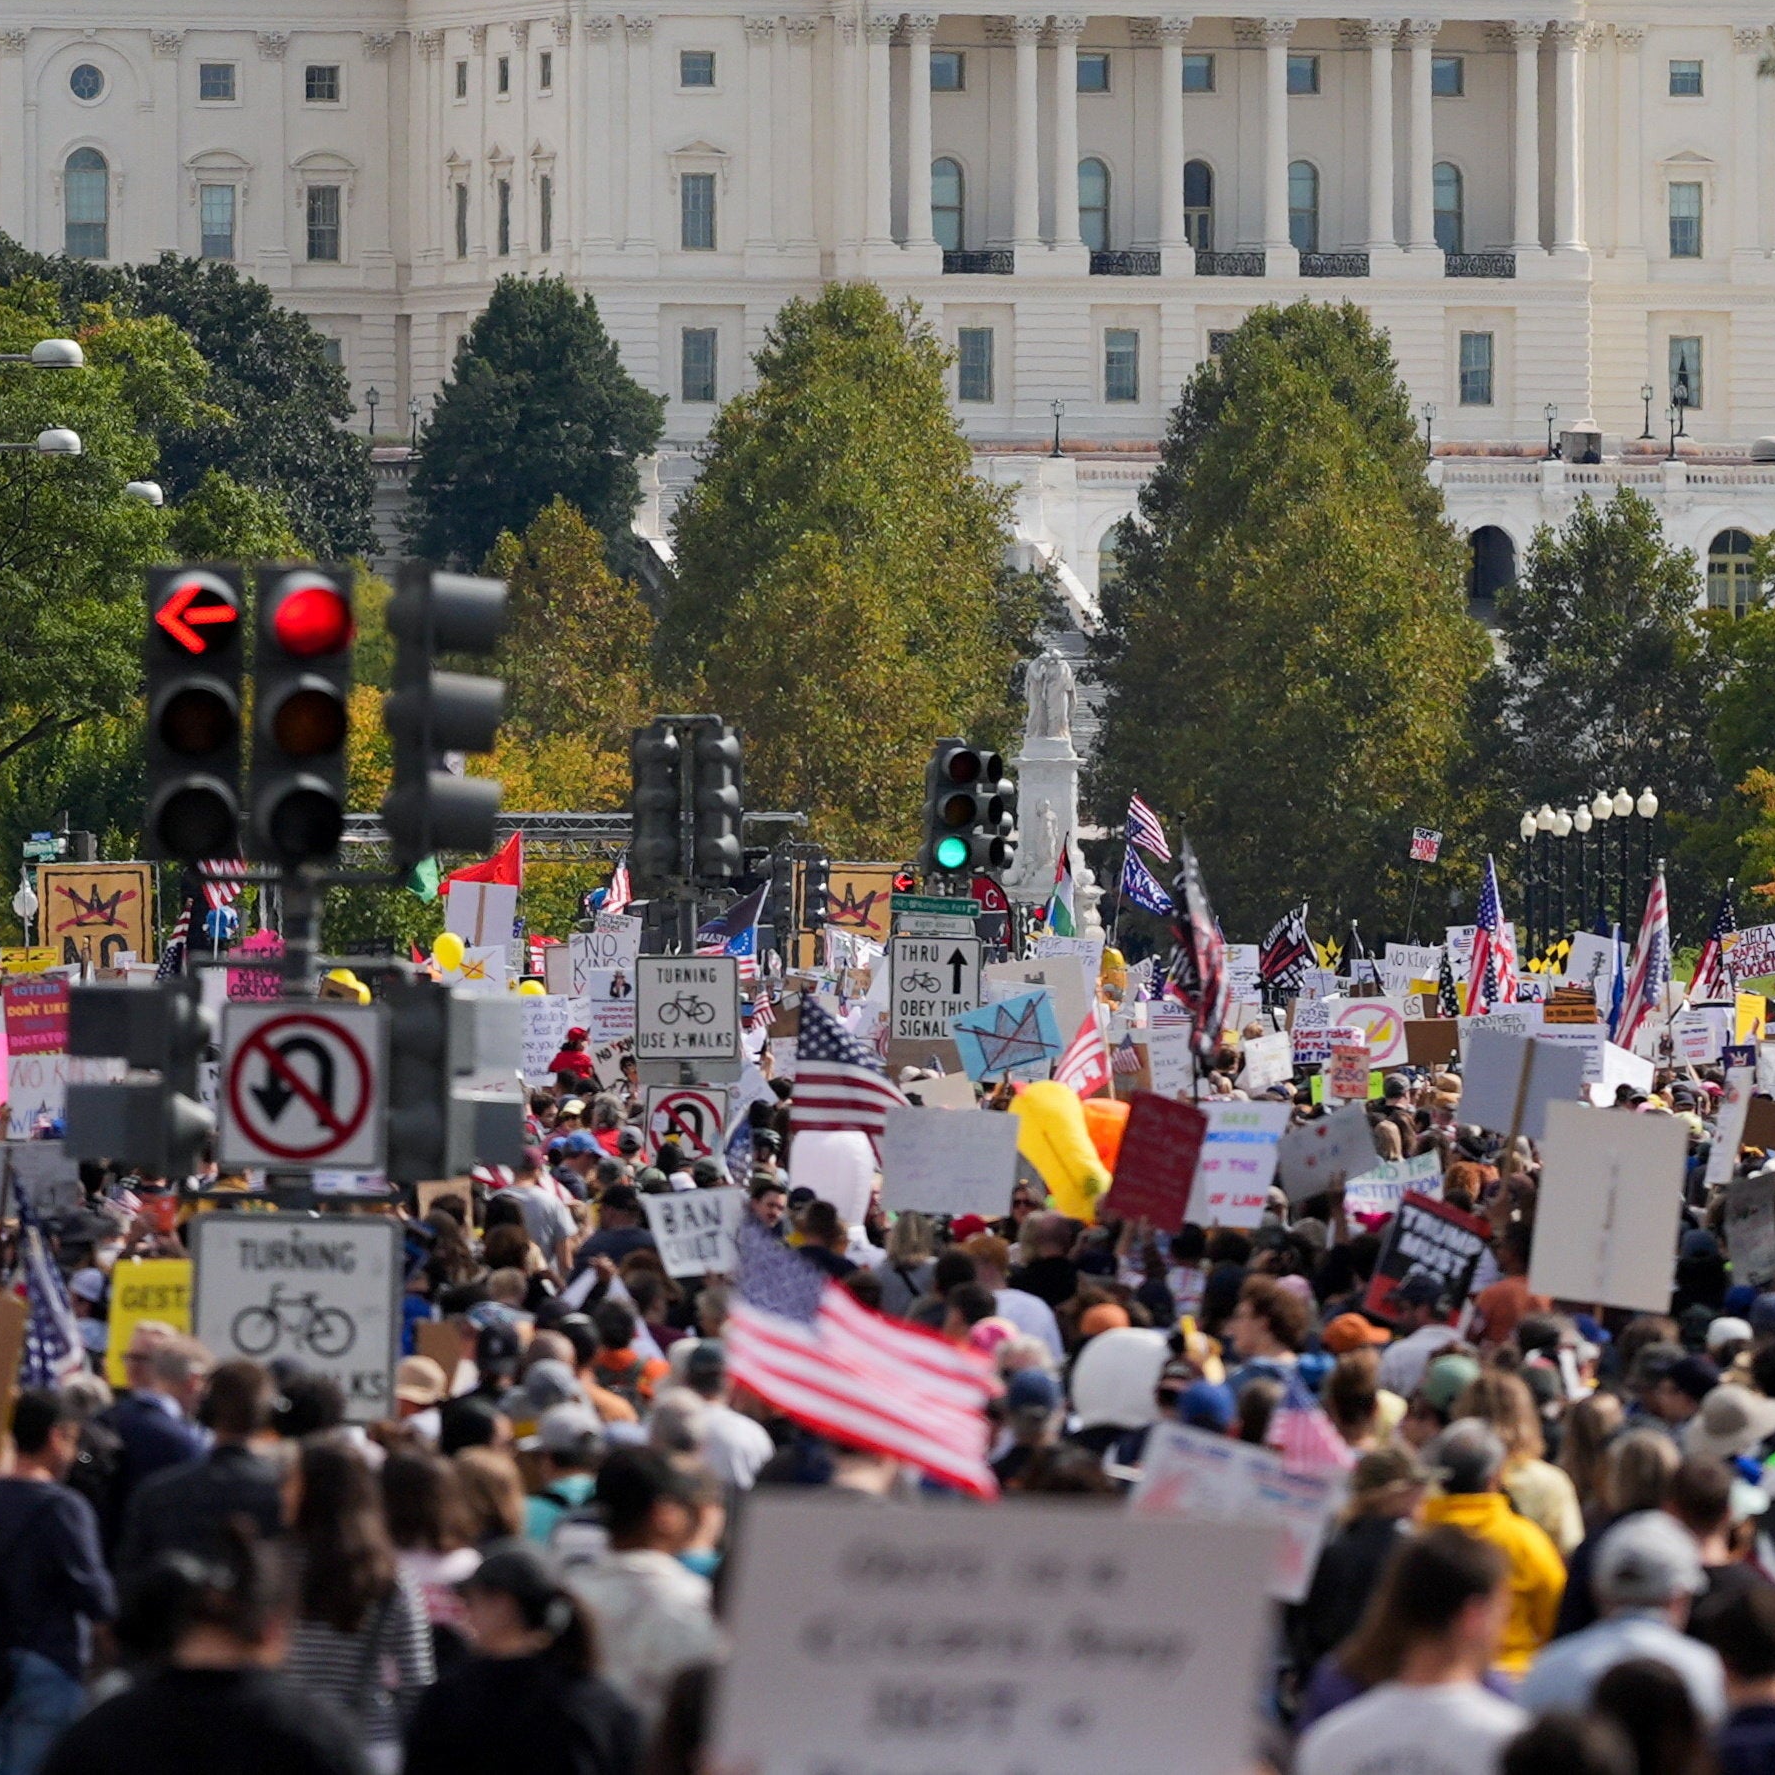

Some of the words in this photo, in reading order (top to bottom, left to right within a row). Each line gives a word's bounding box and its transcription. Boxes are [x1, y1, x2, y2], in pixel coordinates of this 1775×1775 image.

[1766, 927, 1775, 941] A
[584, 934, 618, 959] NO
[901, 945, 939, 963] THRU
[1071, 940, 1094, 954] THE
[1389, 950, 1405, 966] NO
[656, 967, 718, 984] TURNING
[6, 1001, 41, 1017] DON'T
[900, 999, 935, 1017] OBEY
[941, 1000, 972, 1017] THIS
[899, 1019, 949, 1038] SIGNAL
[640, 1032, 666, 1048] USE
[672, 1032, 733, 1049] X-WALKS
[9, 1058, 44, 1089] NO
[660, 1198, 722, 1227] BAN
[1400, 1206, 1486, 1258] TRUMP
[238, 1237, 358, 1274] TURNING
[1396, 1231, 1470, 1278] MUST
